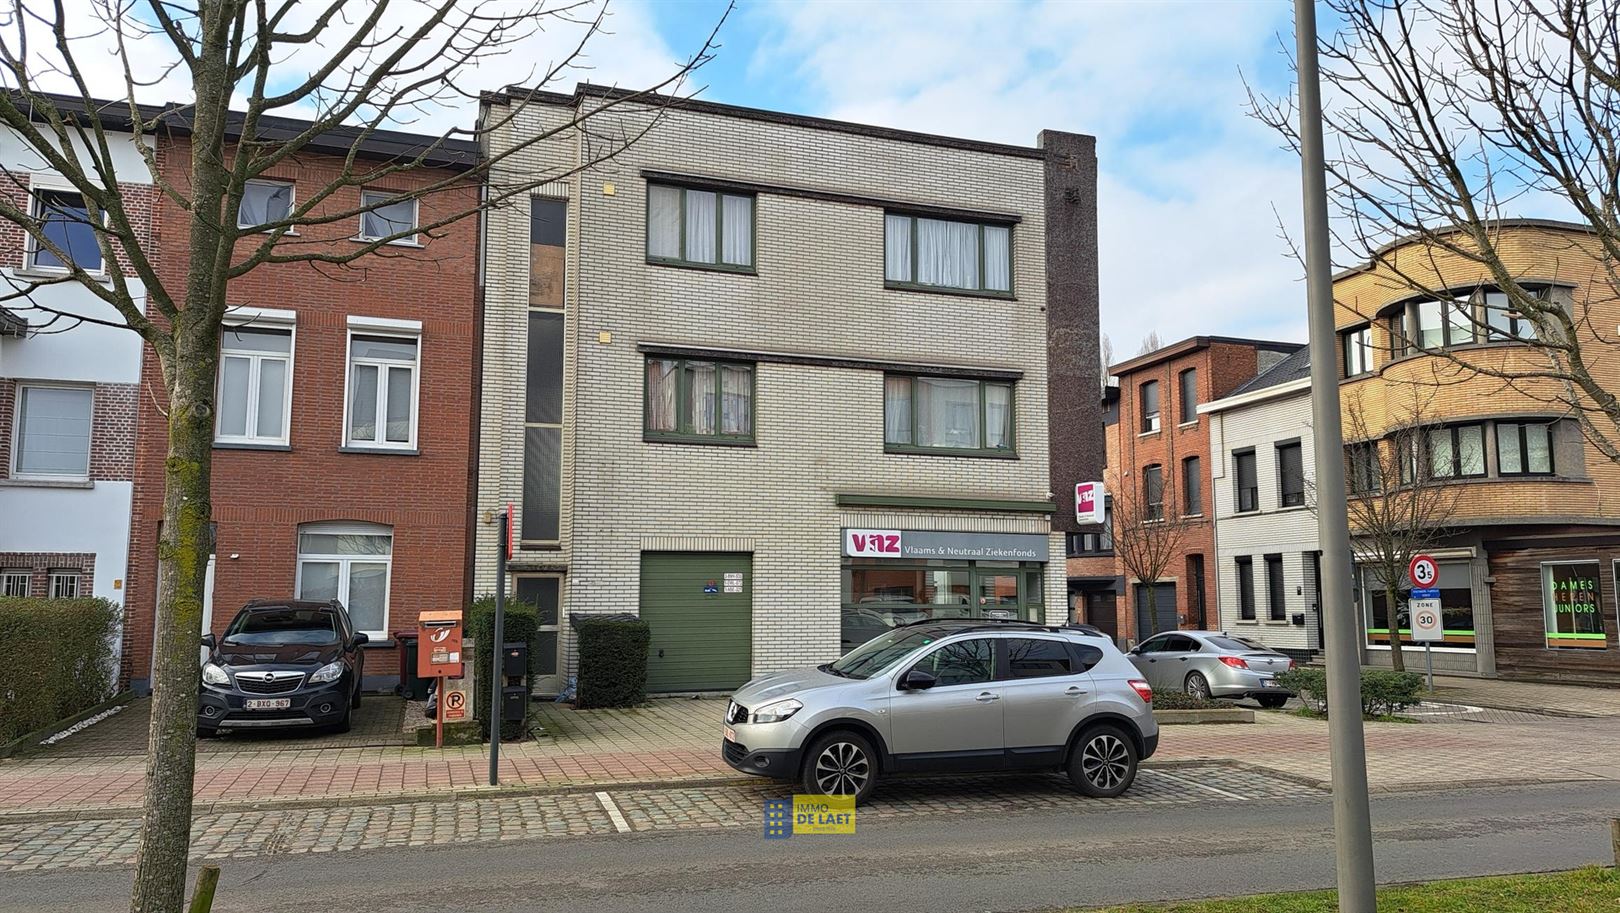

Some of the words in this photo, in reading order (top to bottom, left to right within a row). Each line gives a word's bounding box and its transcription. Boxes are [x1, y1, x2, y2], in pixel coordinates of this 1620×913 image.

[904, 546, 936, 555] Vlaams
[938, 547, 945, 555] &
[947, 547, 984, 556] Neutraal
[985, 547, 1037, 558] Ziekenfonds
[1552, 580, 1593, 590] DAMES
[1419, 615, 1433, 625] 30
